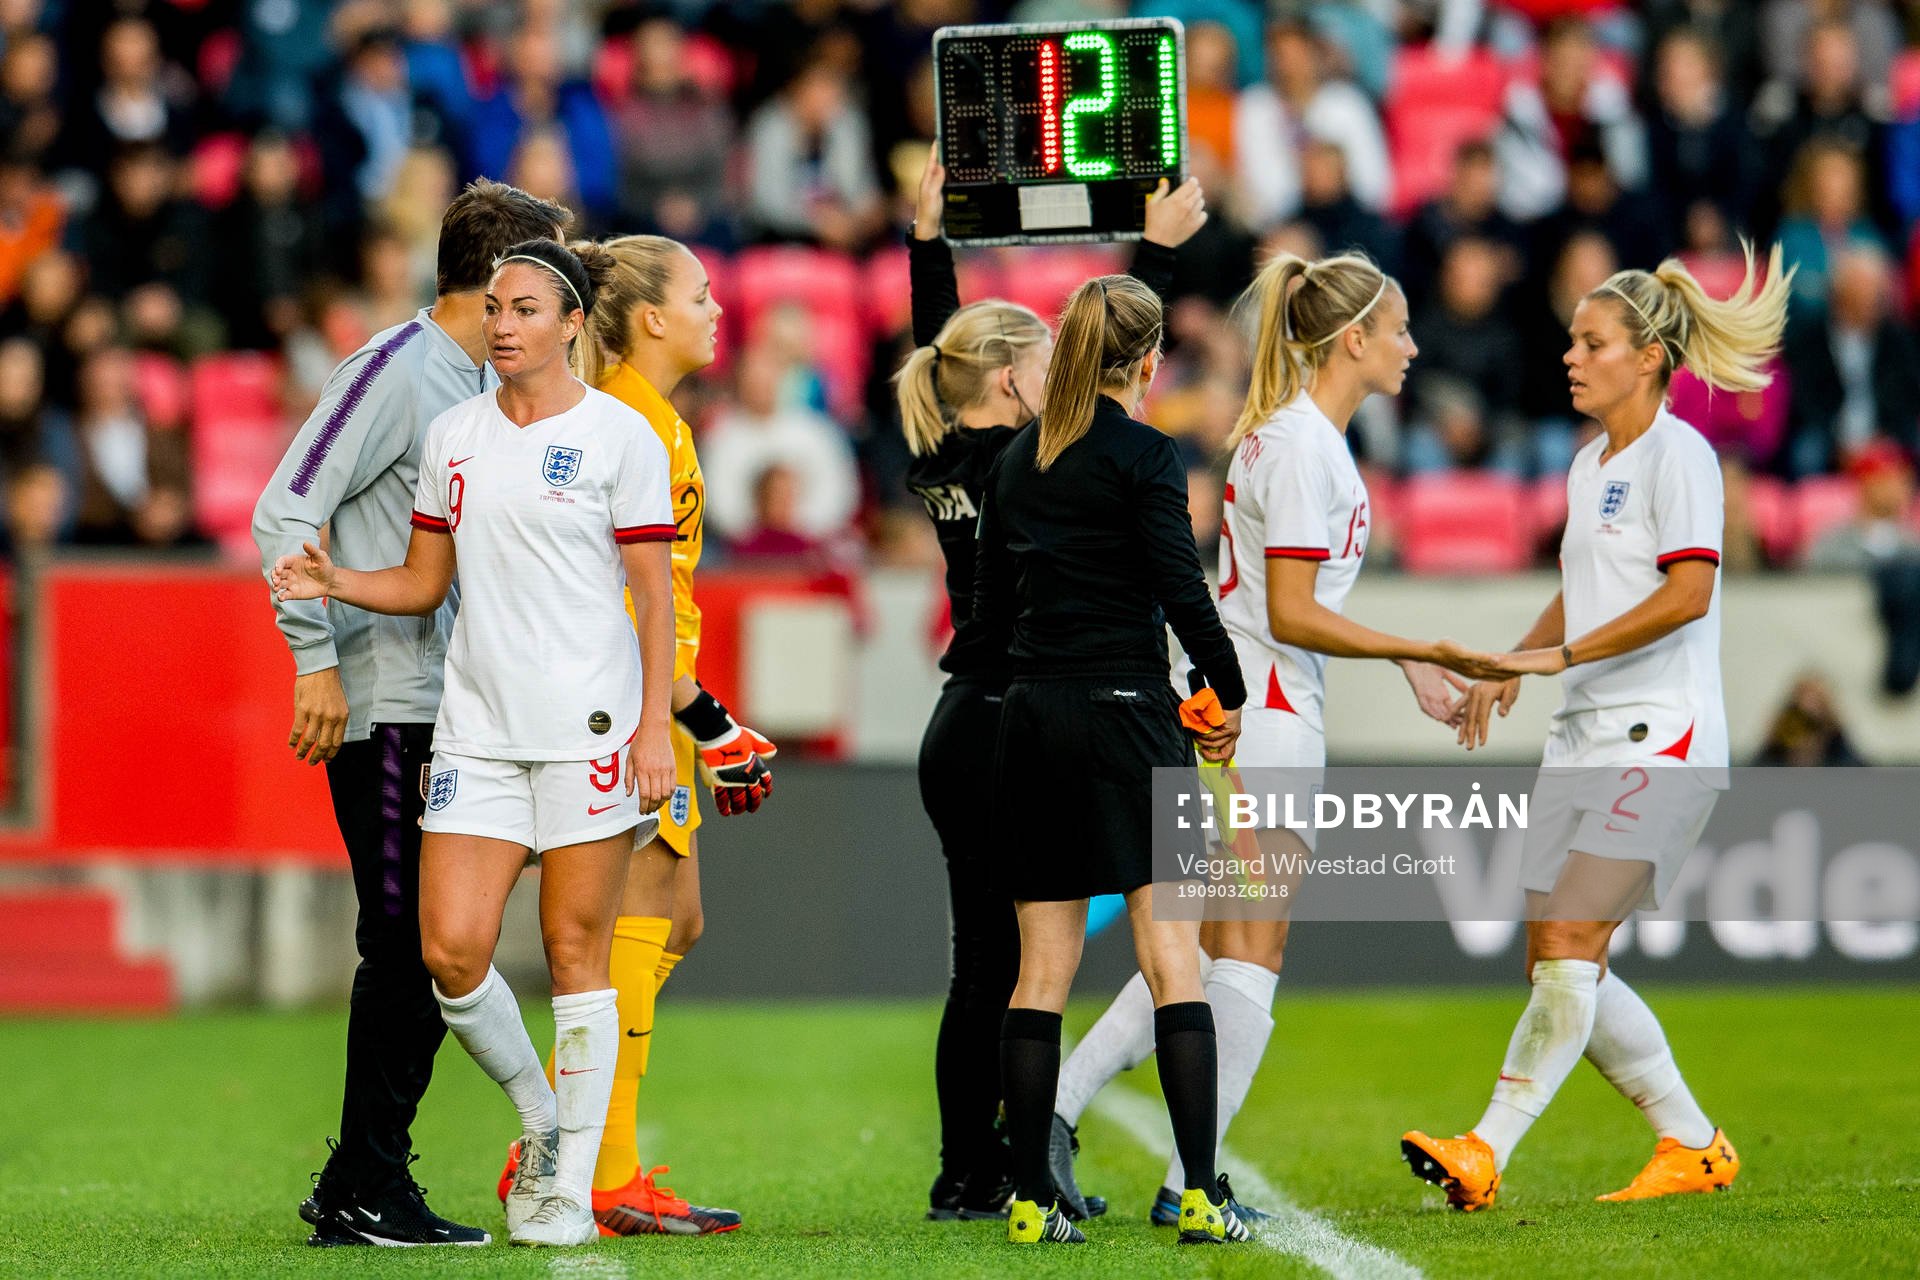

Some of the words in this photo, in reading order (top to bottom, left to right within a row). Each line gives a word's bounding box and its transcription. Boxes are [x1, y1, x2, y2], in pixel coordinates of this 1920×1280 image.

[449, 472, 465, 533] 9
[1341, 501, 1368, 559] 15
[589, 751, 620, 793] 9
[1610, 766, 1650, 821] 2
